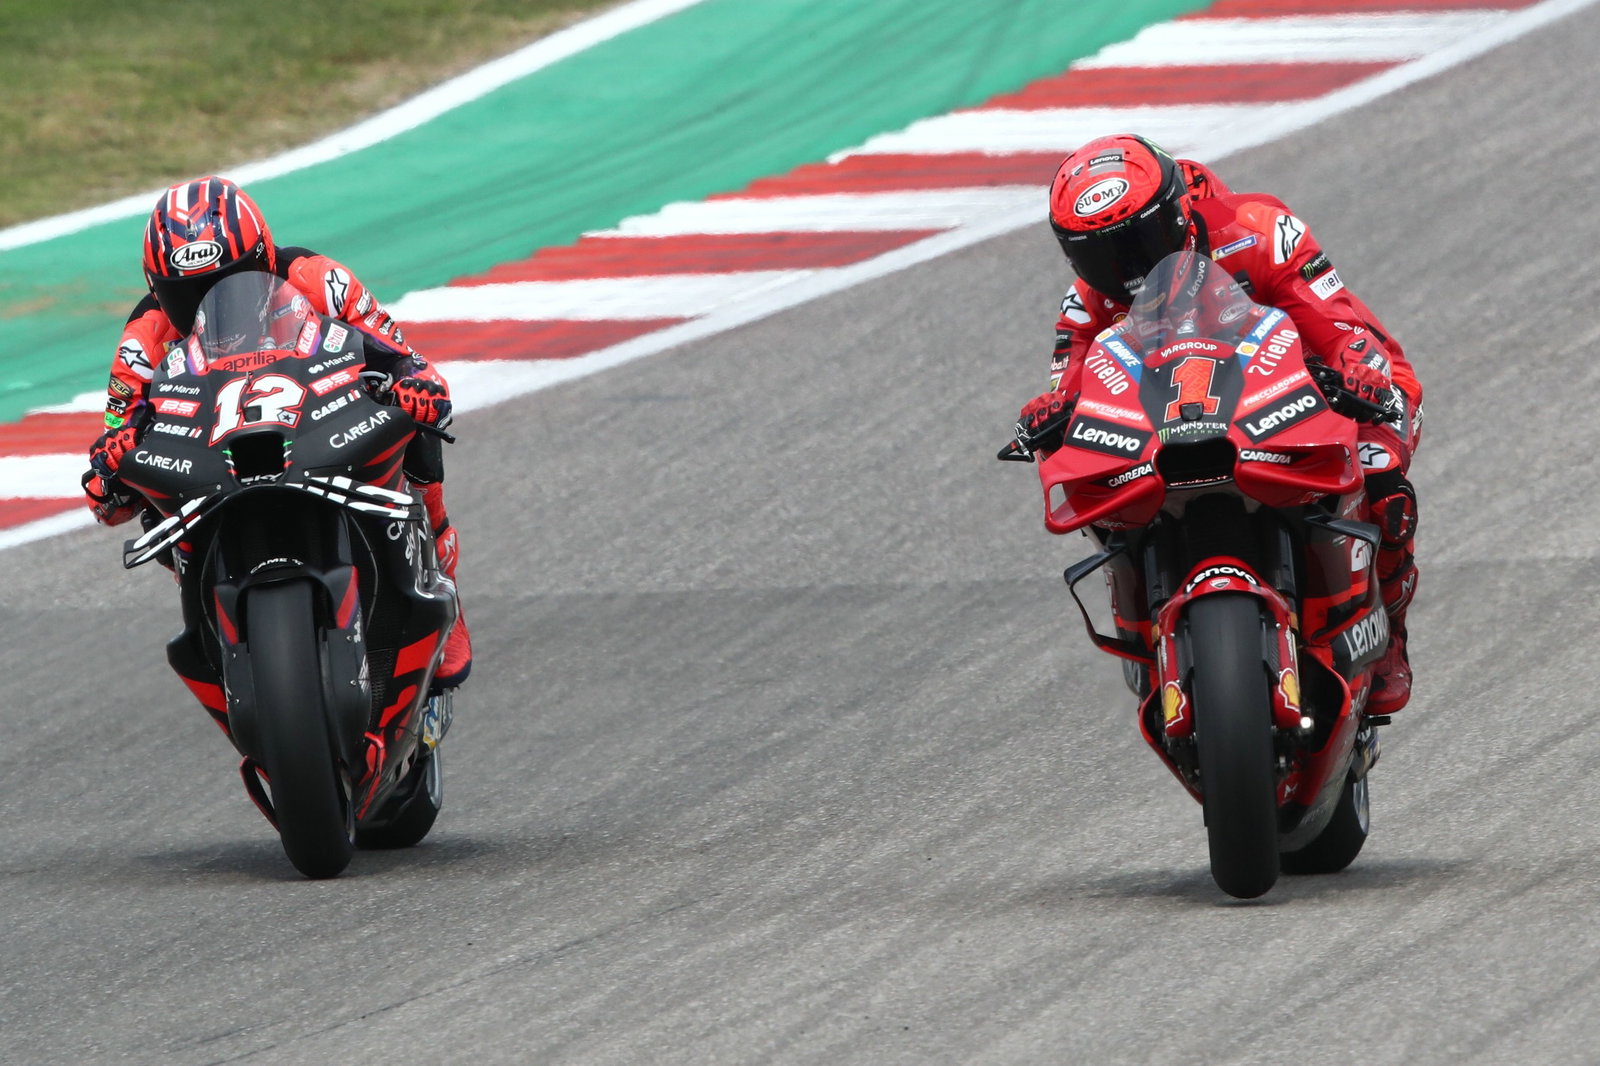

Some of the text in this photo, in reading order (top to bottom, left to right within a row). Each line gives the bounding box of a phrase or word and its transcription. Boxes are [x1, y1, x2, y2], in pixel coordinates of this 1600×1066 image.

[1089, 154, 1120, 166] Lenovo
[1077, 184, 1122, 209] SUOMY
[174, 243, 215, 265] Arai
[1187, 261, 1206, 298] Lenovo
[322, 351, 356, 368] Marsh
[1259, 329, 1299, 367] riello
[223, 351, 277, 371] aprilia
[1089, 358, 1129, 396] riello
[1163, 356, 1221, 423] 1
[1243, 371, 1308, 407] FRECCIAROSSA
[172, 384, 201, 396] Marsh
[159, 399, 198, 412] BS
[208, 373, 307, 447] 12
[310, 396, 348, 421] CASE
[1245, 395, 1317, 436] Lenovo
[153, 422, 189, 438] CASE
[329, 410, 392, 449] CAREAR
[1072, 422, 1140, 452] Lenovo
[135, 450, 193, 475] CAREAR
[1240, 450, 1291, 464] CARRERA
[1108, 463, 1153, 488] CARRERA
[1185, 566, 1258, 593] Lenovo
